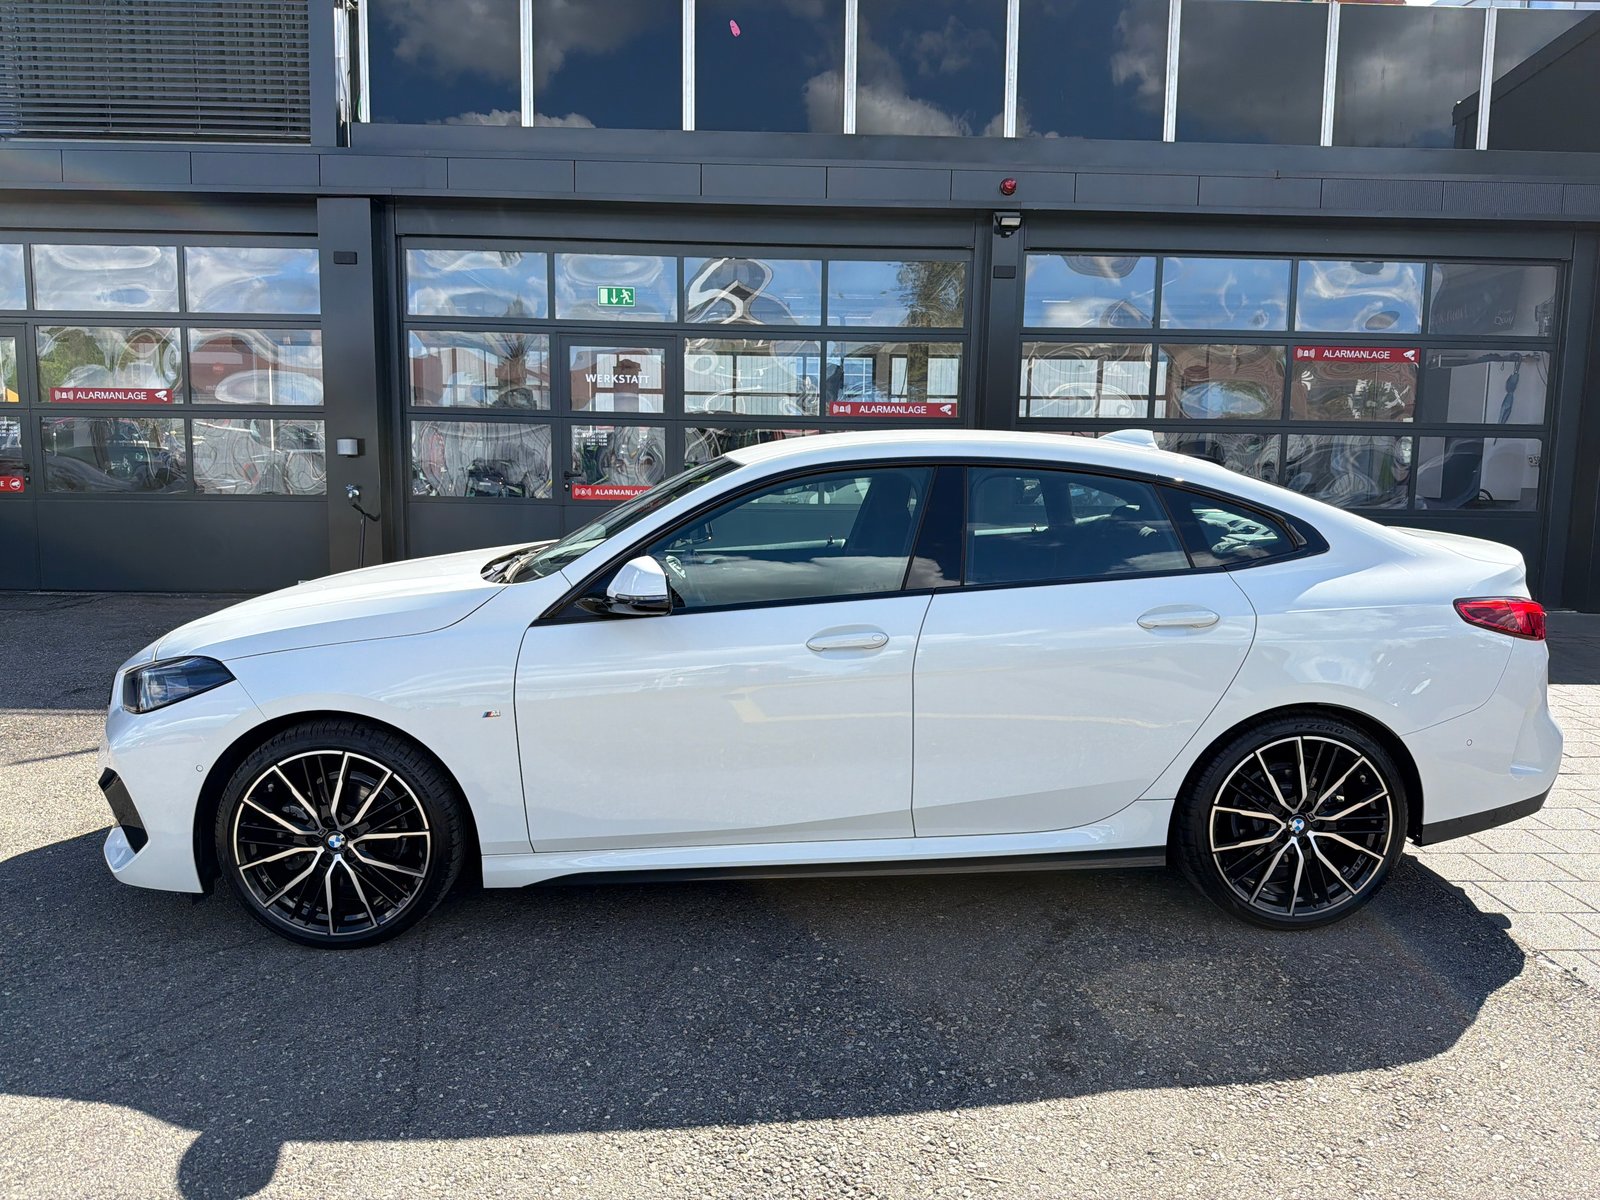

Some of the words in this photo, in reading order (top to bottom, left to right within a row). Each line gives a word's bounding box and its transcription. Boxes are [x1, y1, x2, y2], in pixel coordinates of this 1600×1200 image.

[1322, 350, 1391, 359] ALARMANLAGE
[585, 373, 650, 384] WERKSTATT
[76, 391, 147, 400] ALARMANLAGE
[859, 405, 927, 414] ALARMANLAGE
[595, 488, 648, 497] ALARMANLAG
